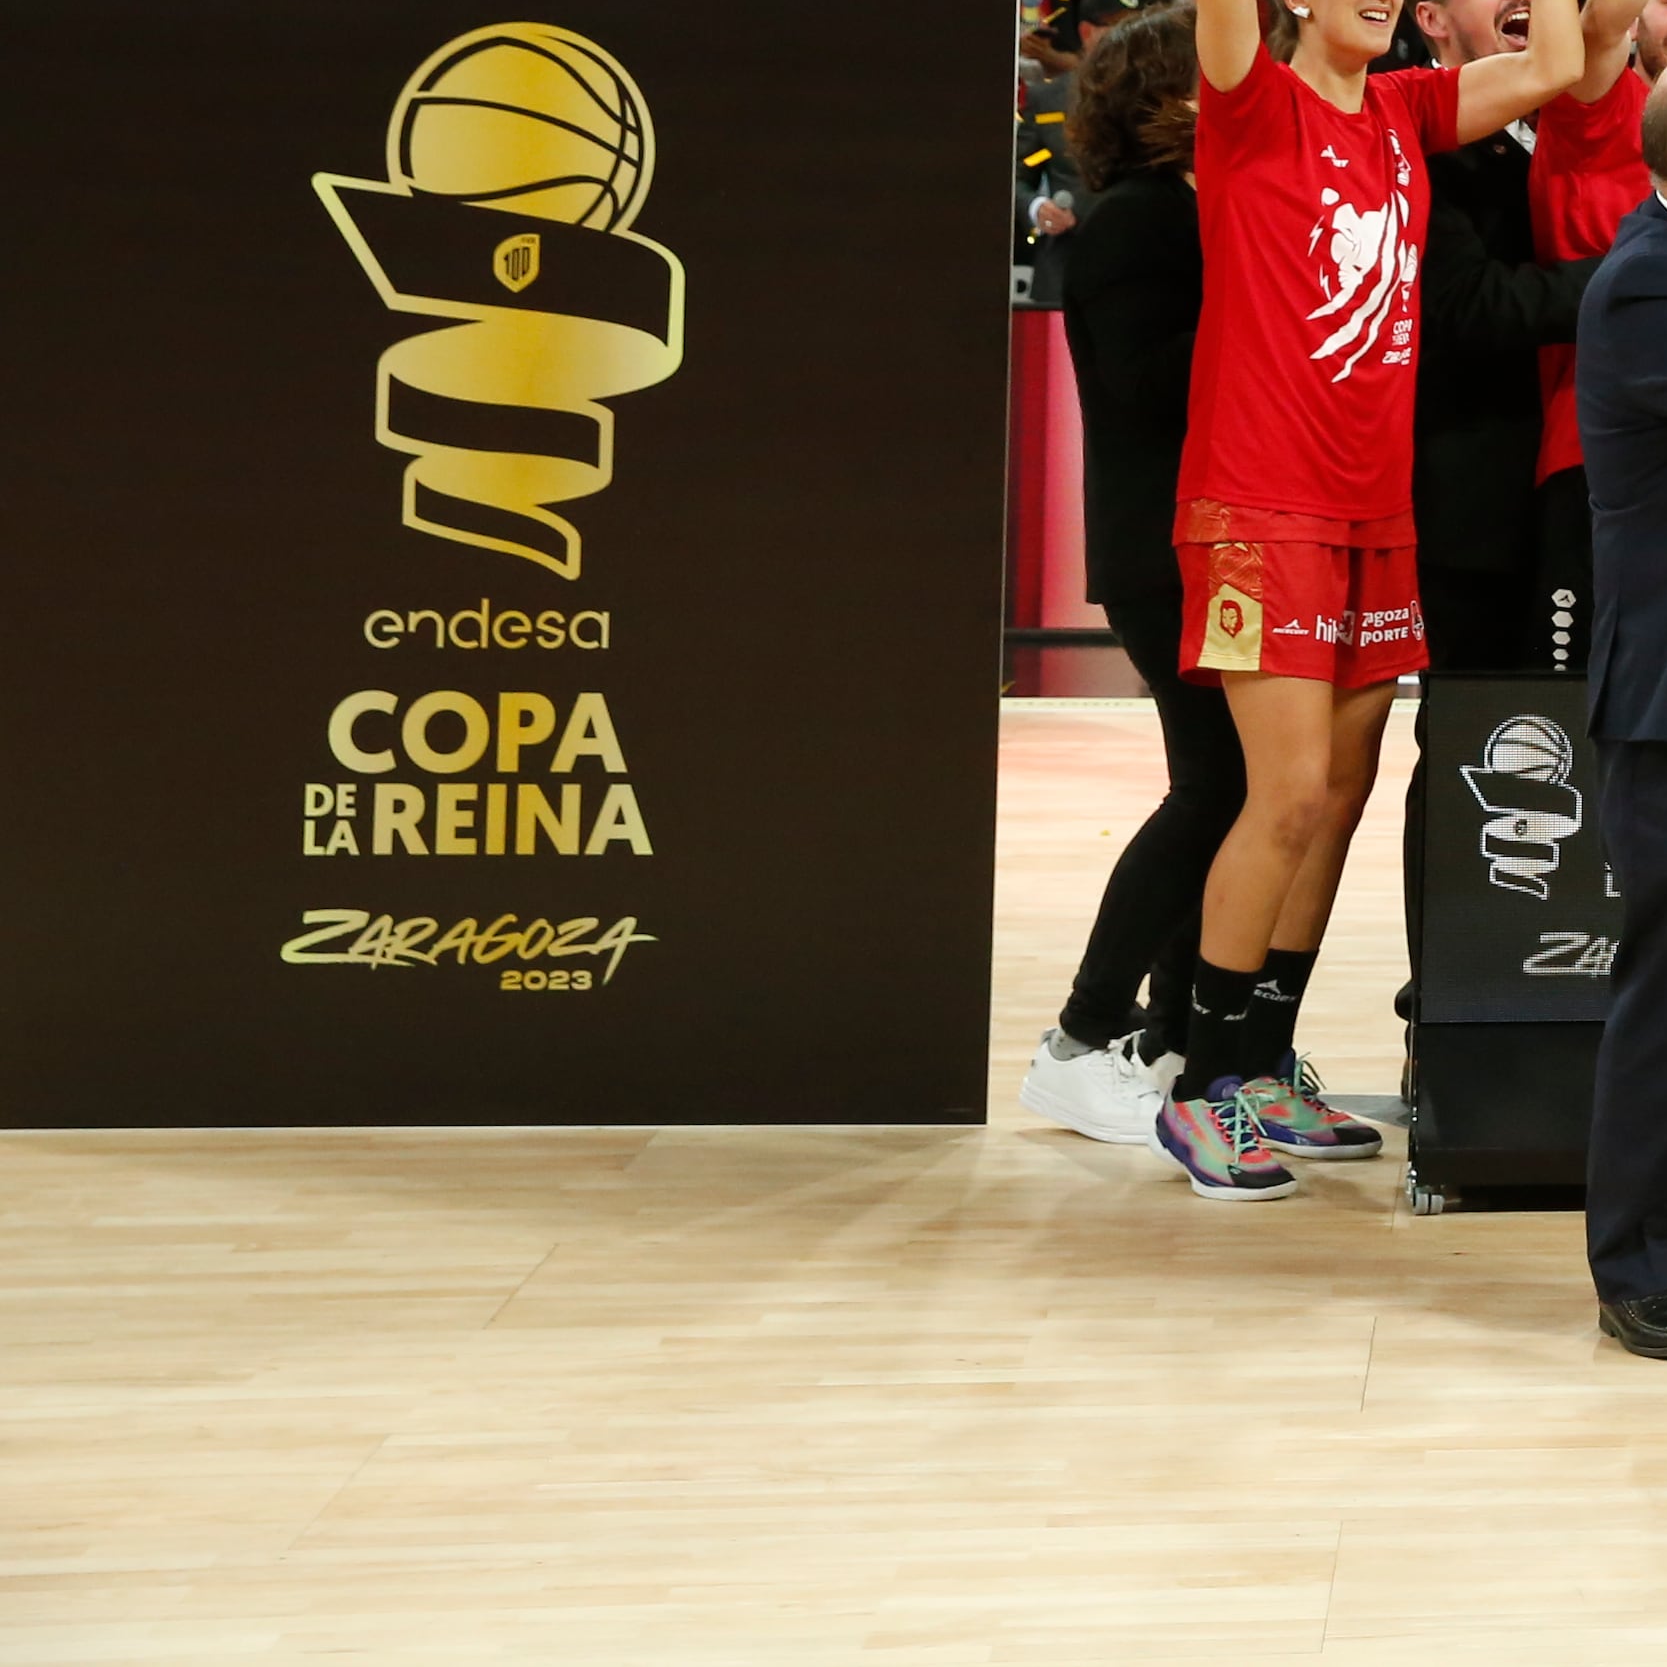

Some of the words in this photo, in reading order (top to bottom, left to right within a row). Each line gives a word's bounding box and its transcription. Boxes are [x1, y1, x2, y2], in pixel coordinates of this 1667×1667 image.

[364, 598, 611, 650] endesa
[328, 690, 629, 775] COPA
[303, 820, 361, 856] LA
[304, 783, 357, 817] DE
[371, 783, 654, 856] REINA
[280, 908, 660, 986] ZARAGOZA
[499, 970, 593, 991] 2023
